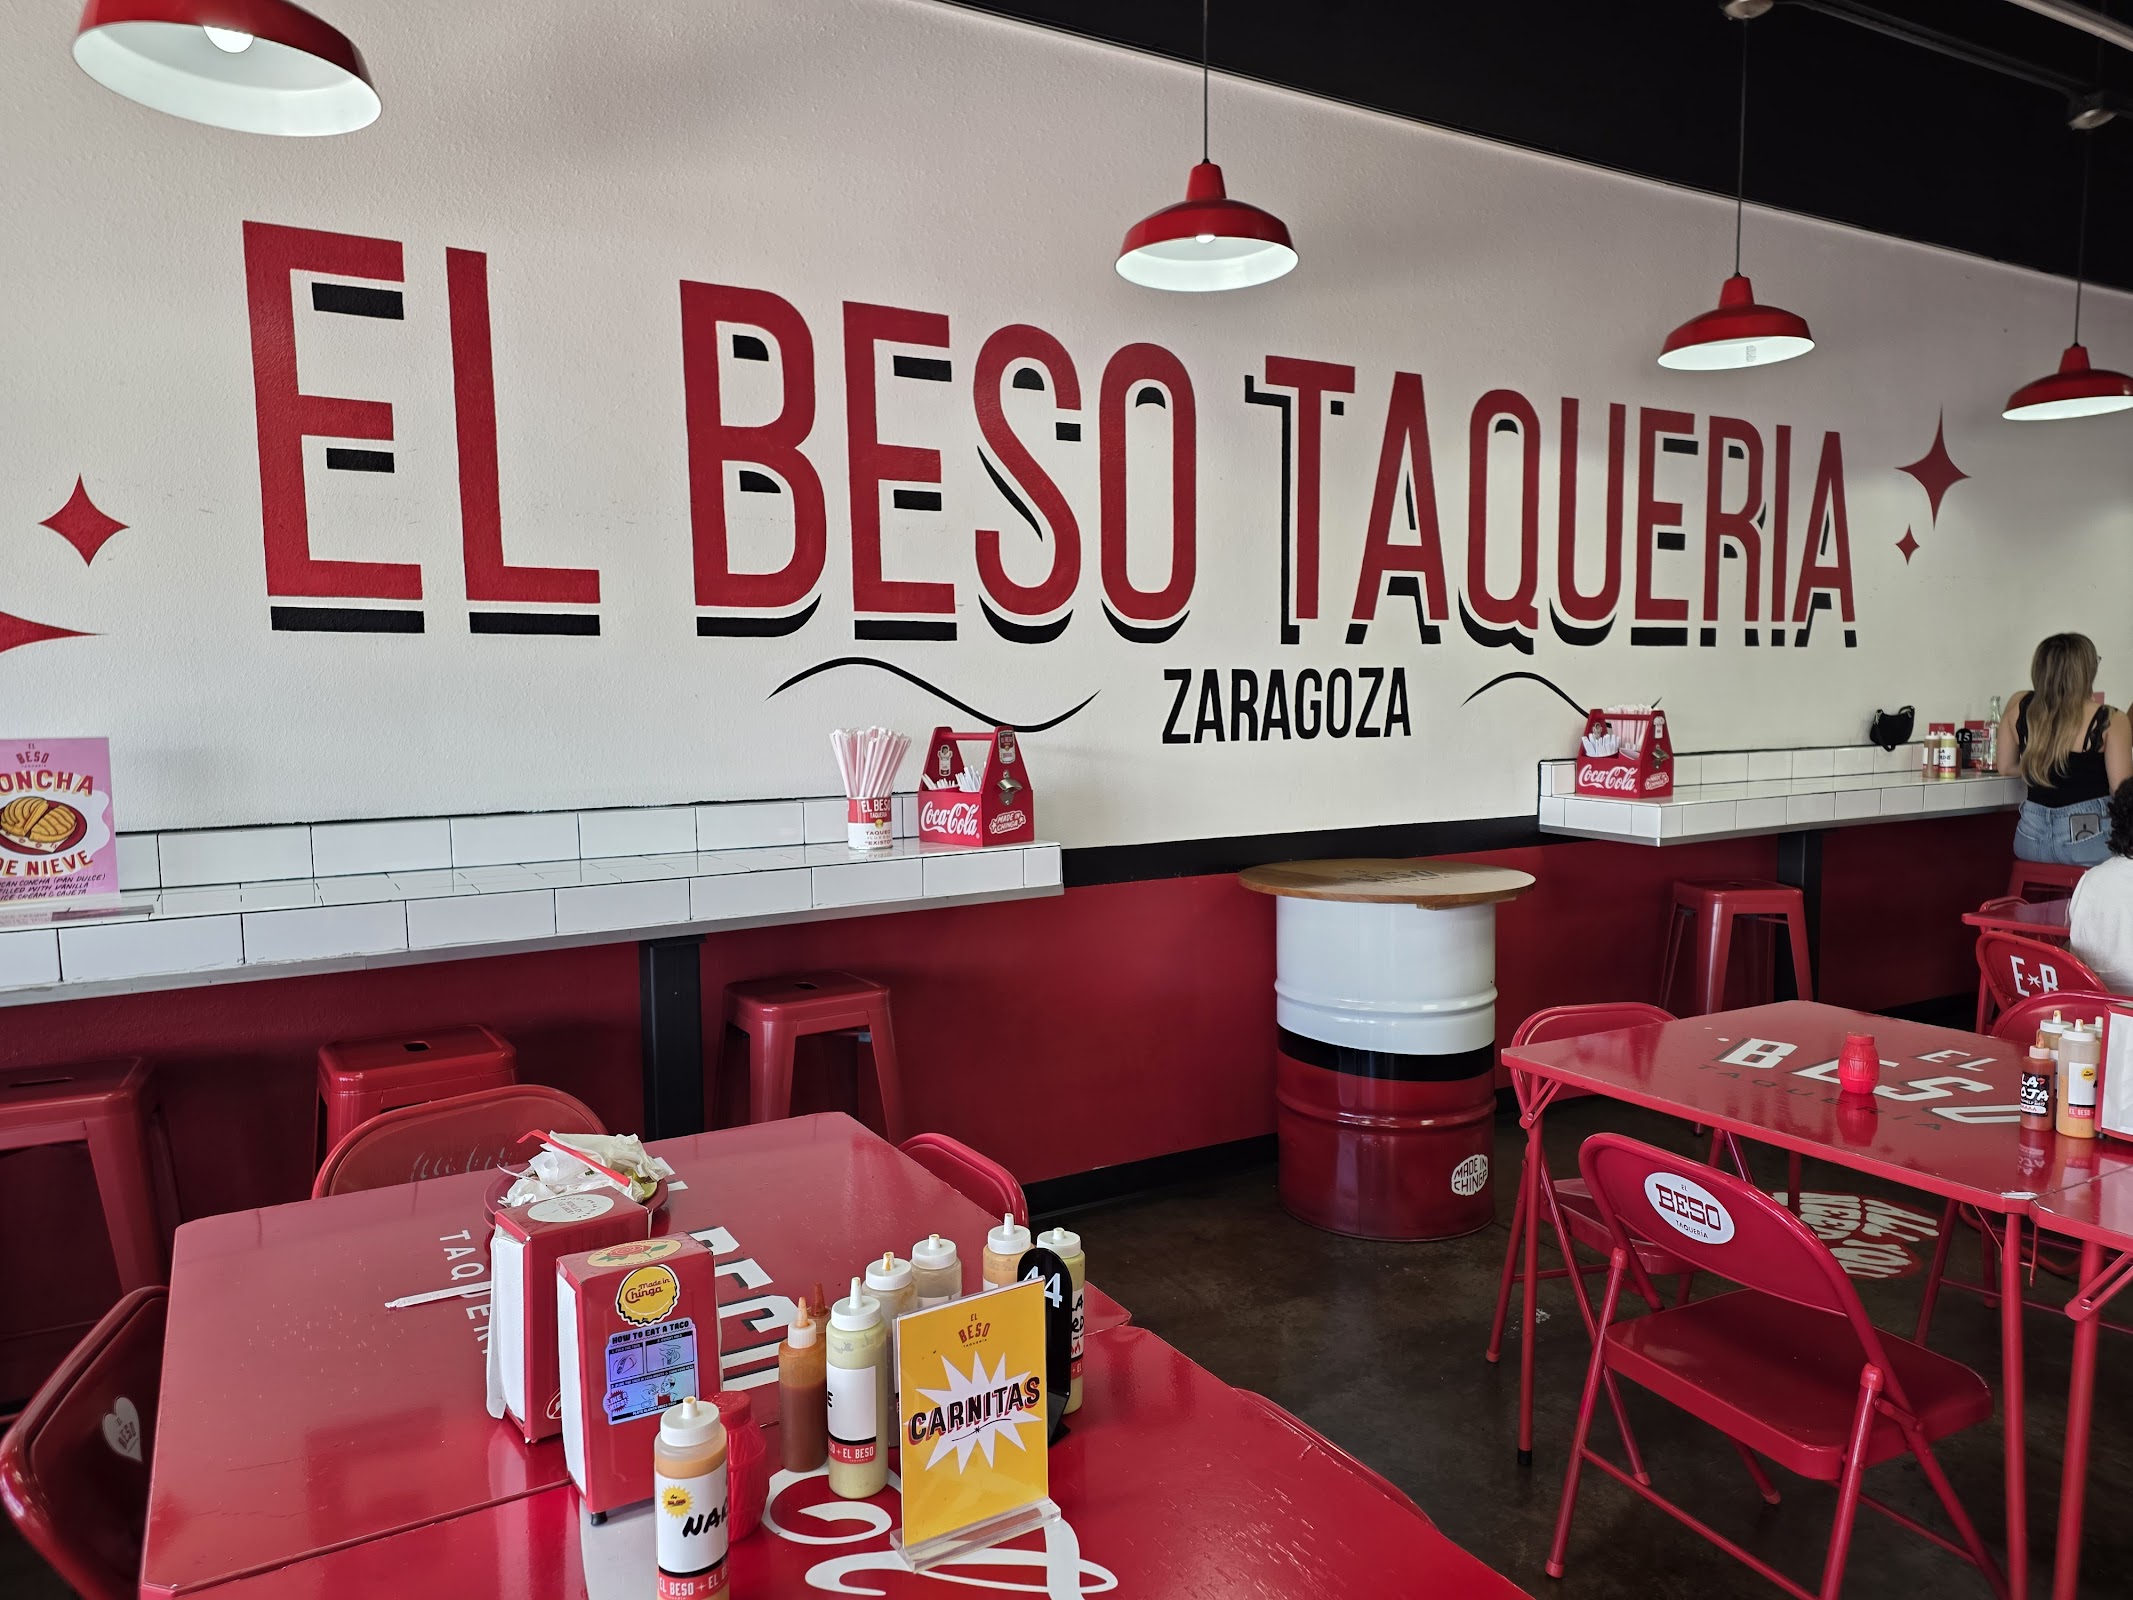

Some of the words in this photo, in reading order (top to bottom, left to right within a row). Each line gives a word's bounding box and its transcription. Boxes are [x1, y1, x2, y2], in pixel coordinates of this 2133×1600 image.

[243, 221, 600, 636] EL
[679, 280, 1197, 644] BESO
[1244, 355, 1857, 654] TAQUERIA
[1162, 667, 1412, 744] ZARAGOZA
[1958, 732, 1970, 741] 15
[16, 751, 49, 764] BESO
[0, 770, 93, 796] ONCHA
[1579, 764, 1638, 791] Coca-Cola
[861, 800, 872, 813] EL
[921, 801, 979, 835] Coca-Cola
[26, 850, 93, 876] NIEVE
[20, 878, 50, 886] CONCHA
[55, 882, 88, 890] VANILLA
[1915, 1049, 1996, 1072] EL
[2021, 1073, 2038, 1088] LA
[2020, 1086, 2049, 1101] OJA
[1454, 1157, 1478, 1180] MADE
[1480, 1157, 1487, 1171] IN
[1681, 1184, 1688, 1192] EL
[1655, 1183, 1721, 1231] BESO
[625, 1286, 663, 1303] Chinga
[638, 1280, 662, 1292] Made
[970, 1312, 978, 1321] EL
[612, 1333, 631, 1344] HOW
[633, 1331, 643, 1340] TO
[645, 1327, 661, 1337] EAT
[662, 1325, 668, 1333] A
[670, 1320, 689, 1331] TACO
[958, 1322, 991, 1344] BESO
[908, 1377, 1040, 1445] CARNITAS
[842, 1448, 851, 1459] EL
[855, 1446, 874, 1459] BESO
[659, 1577, 667, 1593] EL
[669, 1582, 694, 1596] BESO
[708, 1574, 719, 1590] EL
